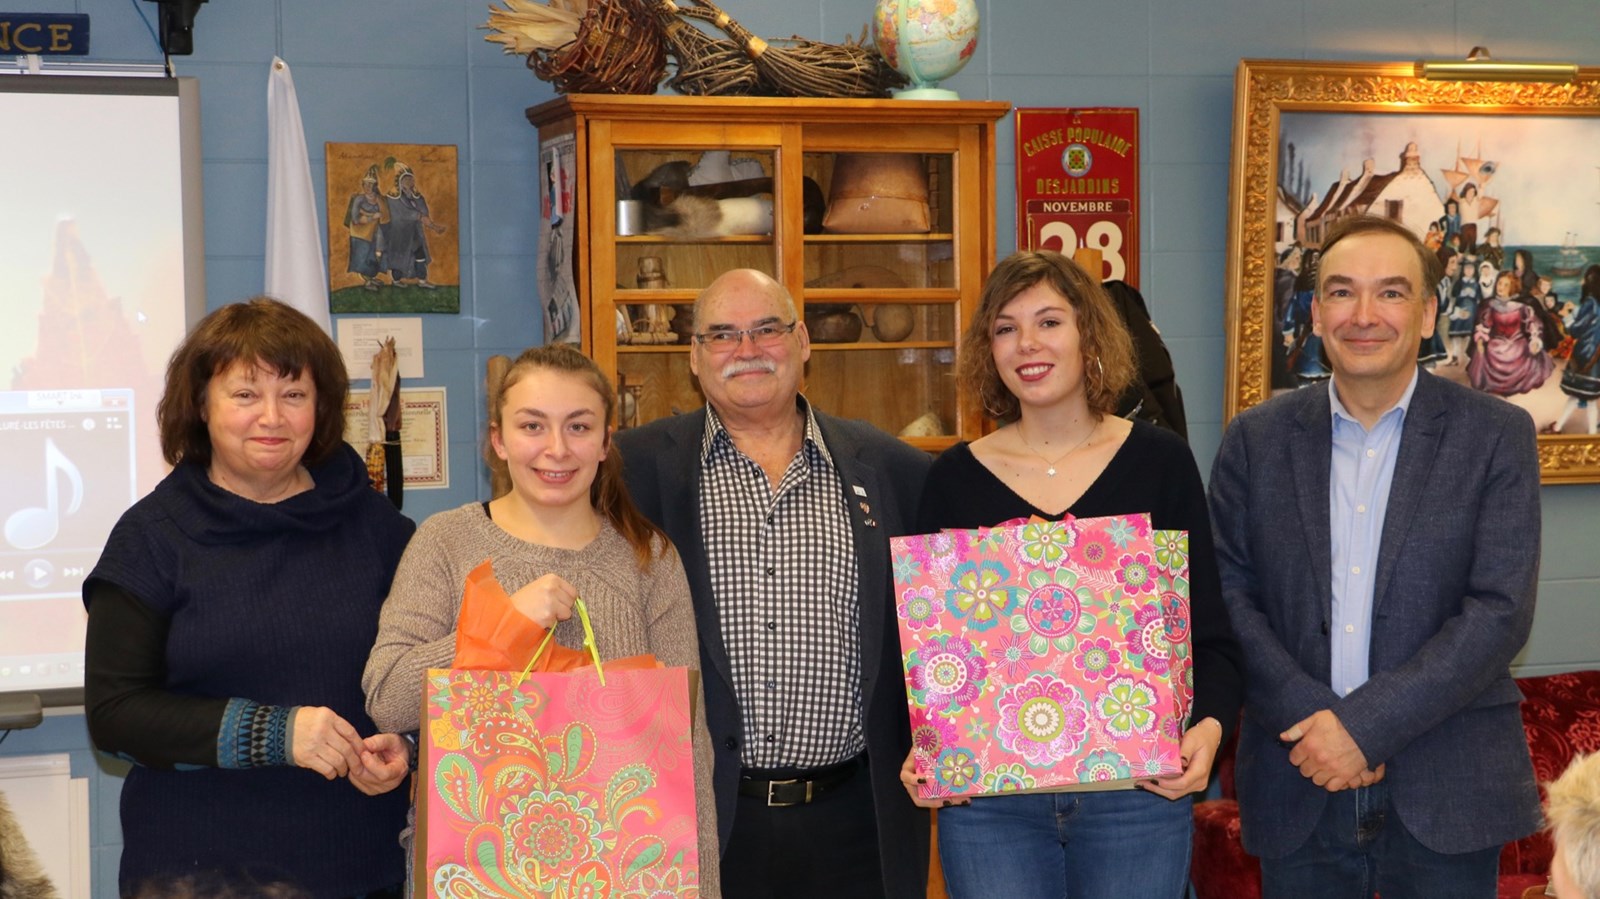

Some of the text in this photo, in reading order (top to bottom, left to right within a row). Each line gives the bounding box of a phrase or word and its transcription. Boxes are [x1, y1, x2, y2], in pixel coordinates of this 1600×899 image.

[1023, 127, 1133, 158] CAISSE POPULAIRE
[1036, 178, 1120, 195] DESJARDINS
[1043, 202, 1113, 213] NOVEMBRE
